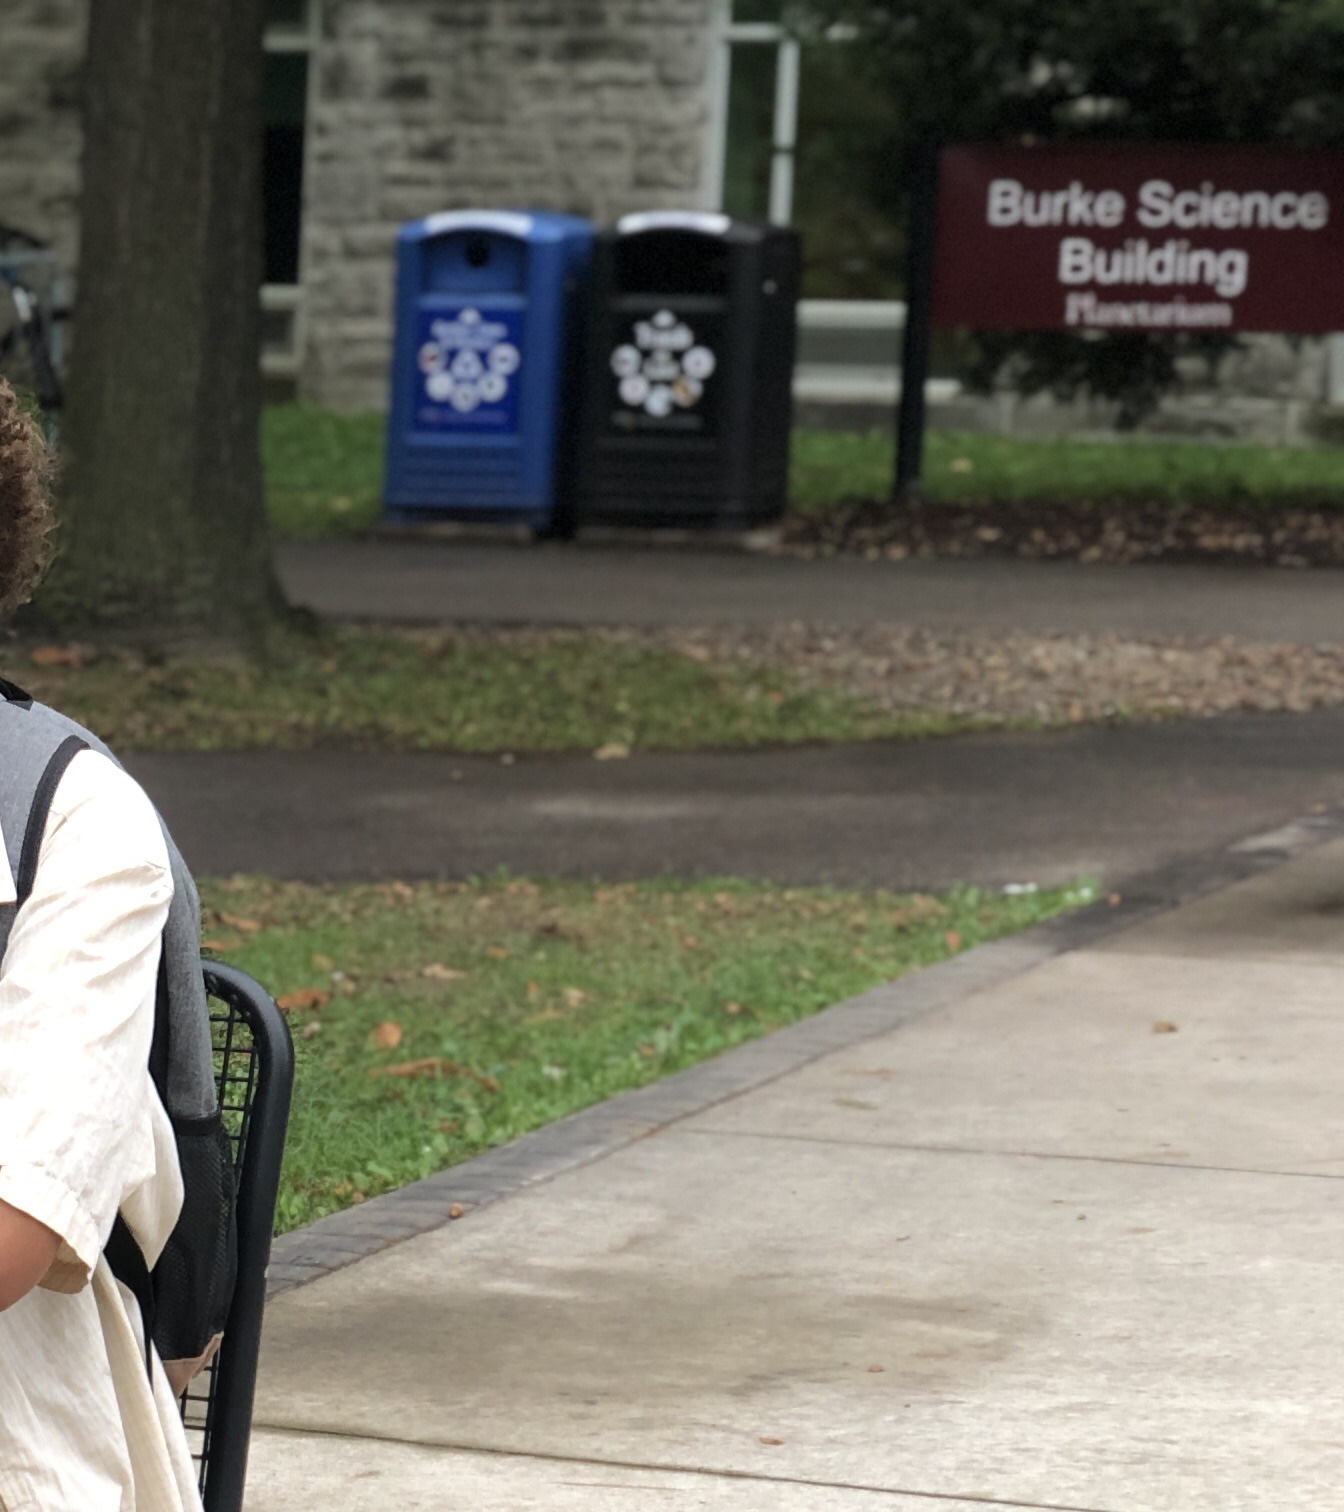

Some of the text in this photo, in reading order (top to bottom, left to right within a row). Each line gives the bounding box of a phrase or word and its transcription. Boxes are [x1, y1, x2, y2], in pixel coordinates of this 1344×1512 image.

[987, 179, 1330, 229] Burke Science
[1058, 237, 1249, 297] Building
